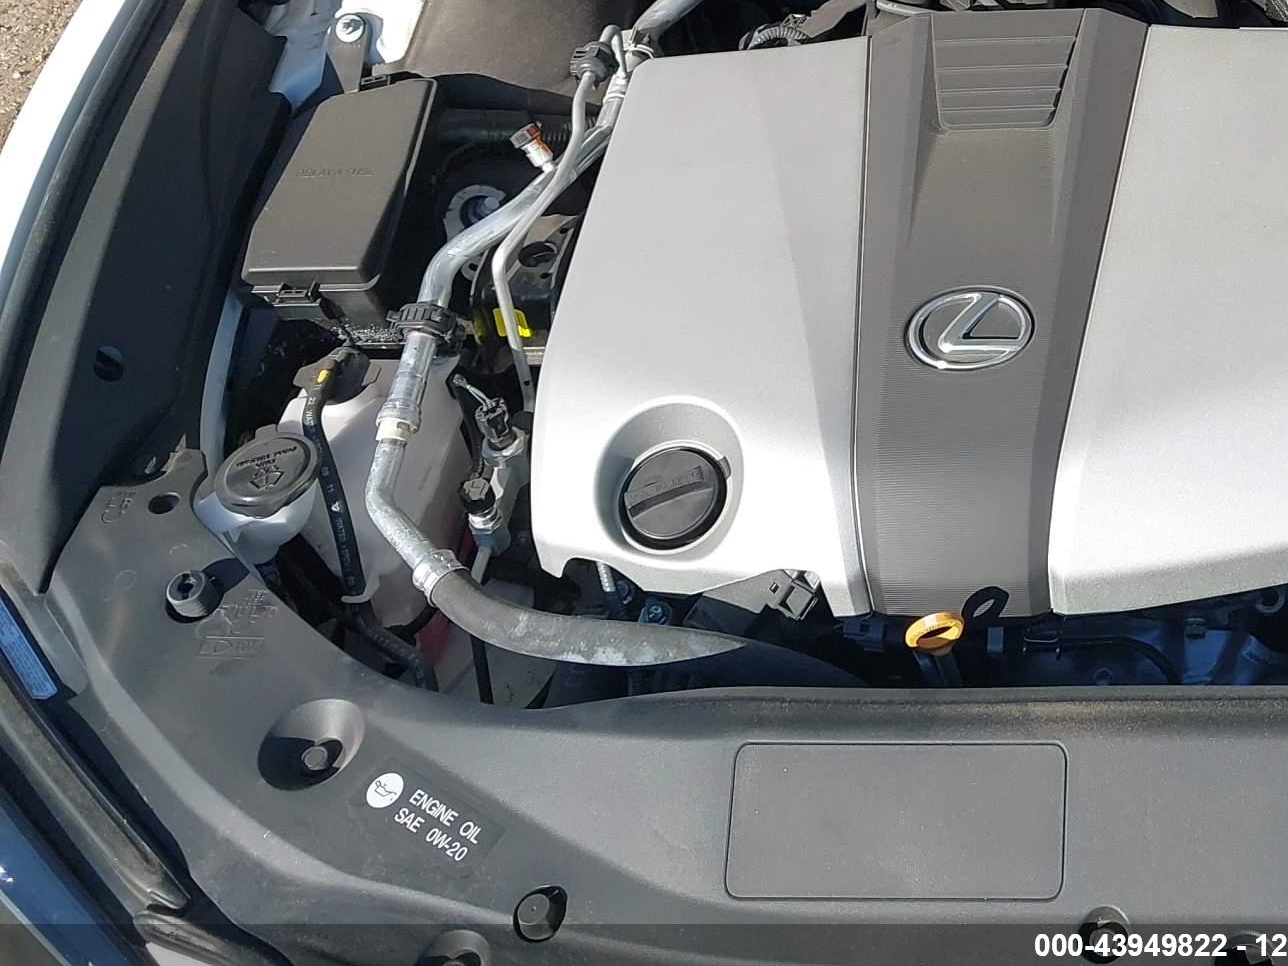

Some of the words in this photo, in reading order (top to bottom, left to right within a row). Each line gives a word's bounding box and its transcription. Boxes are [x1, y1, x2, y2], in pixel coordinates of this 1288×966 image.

[394, 807, 425, 833] SAE
[425, 828, 468, 861] 0W-20
[409, 789, 459, 826] ENGINE
[459, 821, 481, 844] OIL
